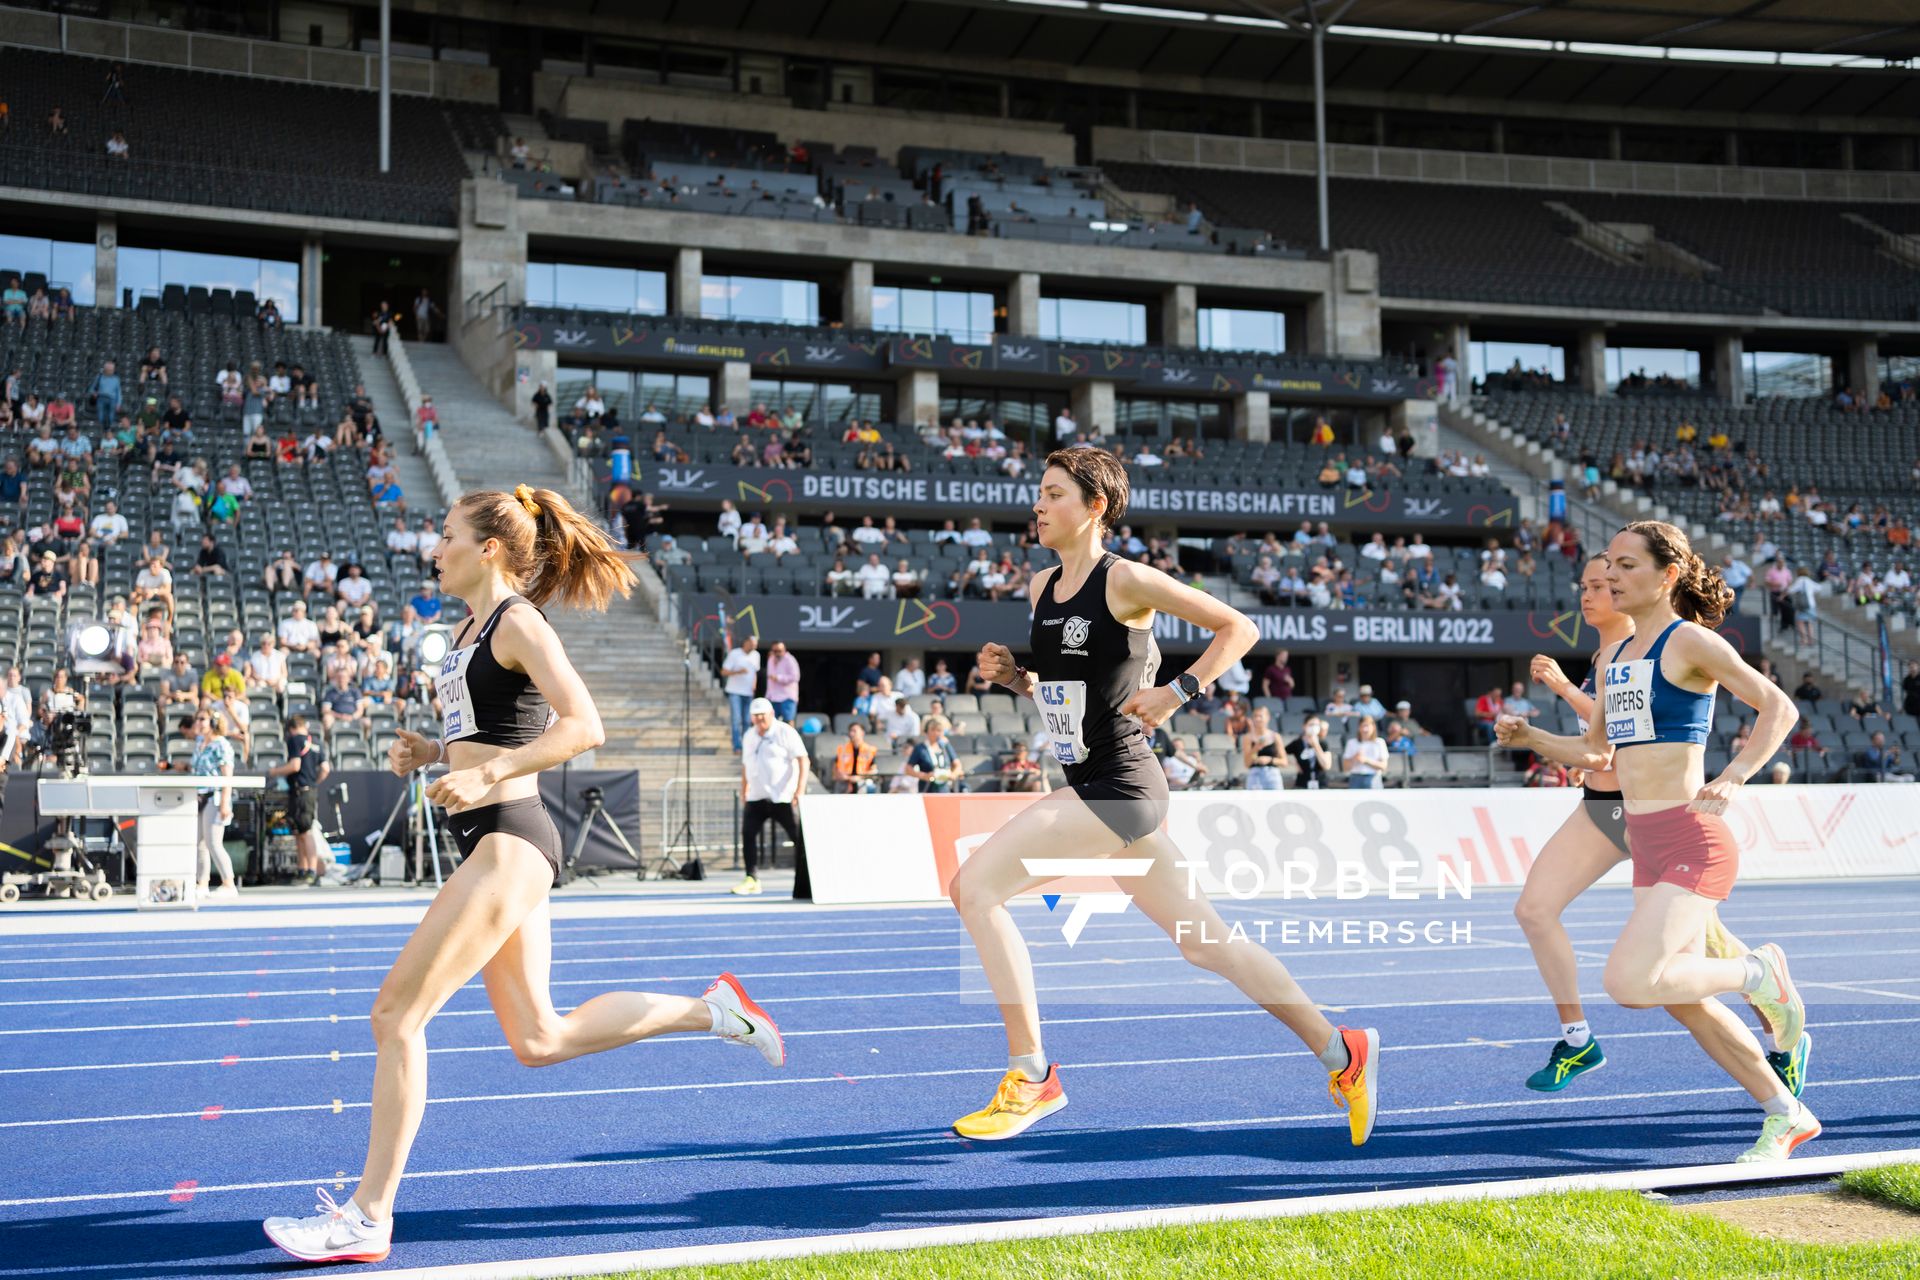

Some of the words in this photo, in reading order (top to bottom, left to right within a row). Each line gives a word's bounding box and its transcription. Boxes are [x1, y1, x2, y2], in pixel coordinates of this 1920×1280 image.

[658, 468, 704, 487] DLV
[803, 476, 926, 501] DEUTSCHE
[1130, 488, 1335, 515] MEISTERSCHAFTEN
[799, 605, 854, 627] DLV
[1353, 616, 1434, 643] BERLIN
[1438, 618, 1494, 644] 2022
[1046, 712, 1074, 735] STAHL
[1616, 722, 1633, 732] PLAN
